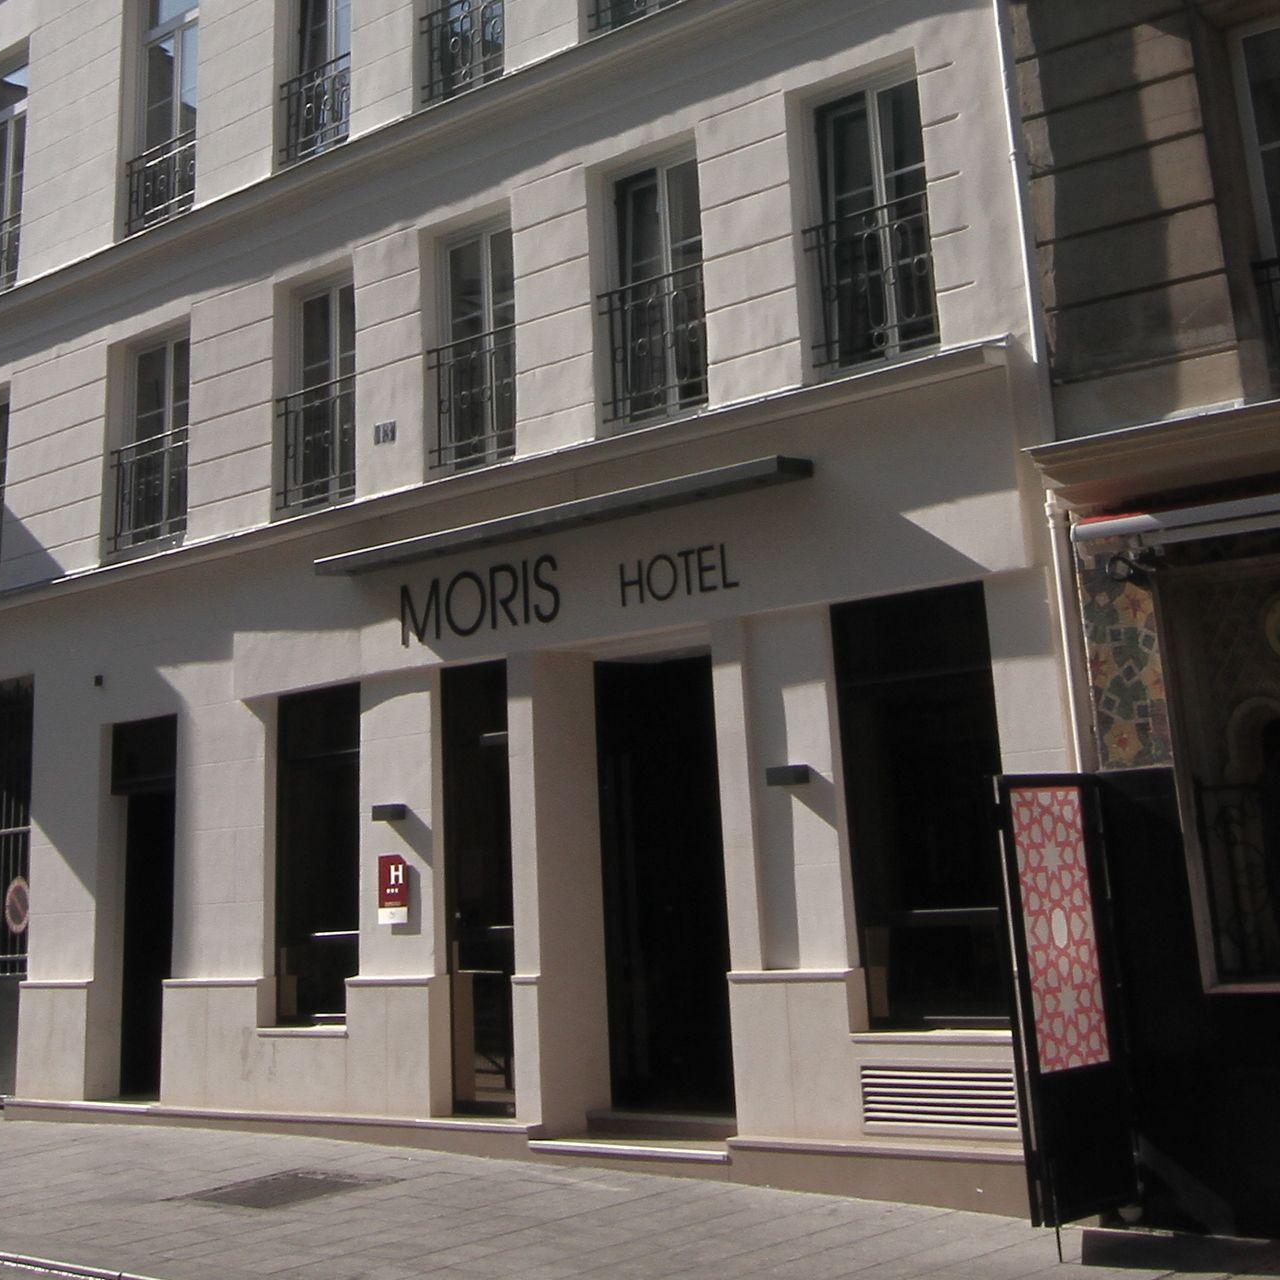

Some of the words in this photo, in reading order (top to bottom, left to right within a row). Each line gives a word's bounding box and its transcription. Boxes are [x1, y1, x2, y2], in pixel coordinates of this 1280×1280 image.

[400, 554, 561, 646] MORIS
[619, 543, 740, 607] HOTEL
[390, 864, 404, 885] H
